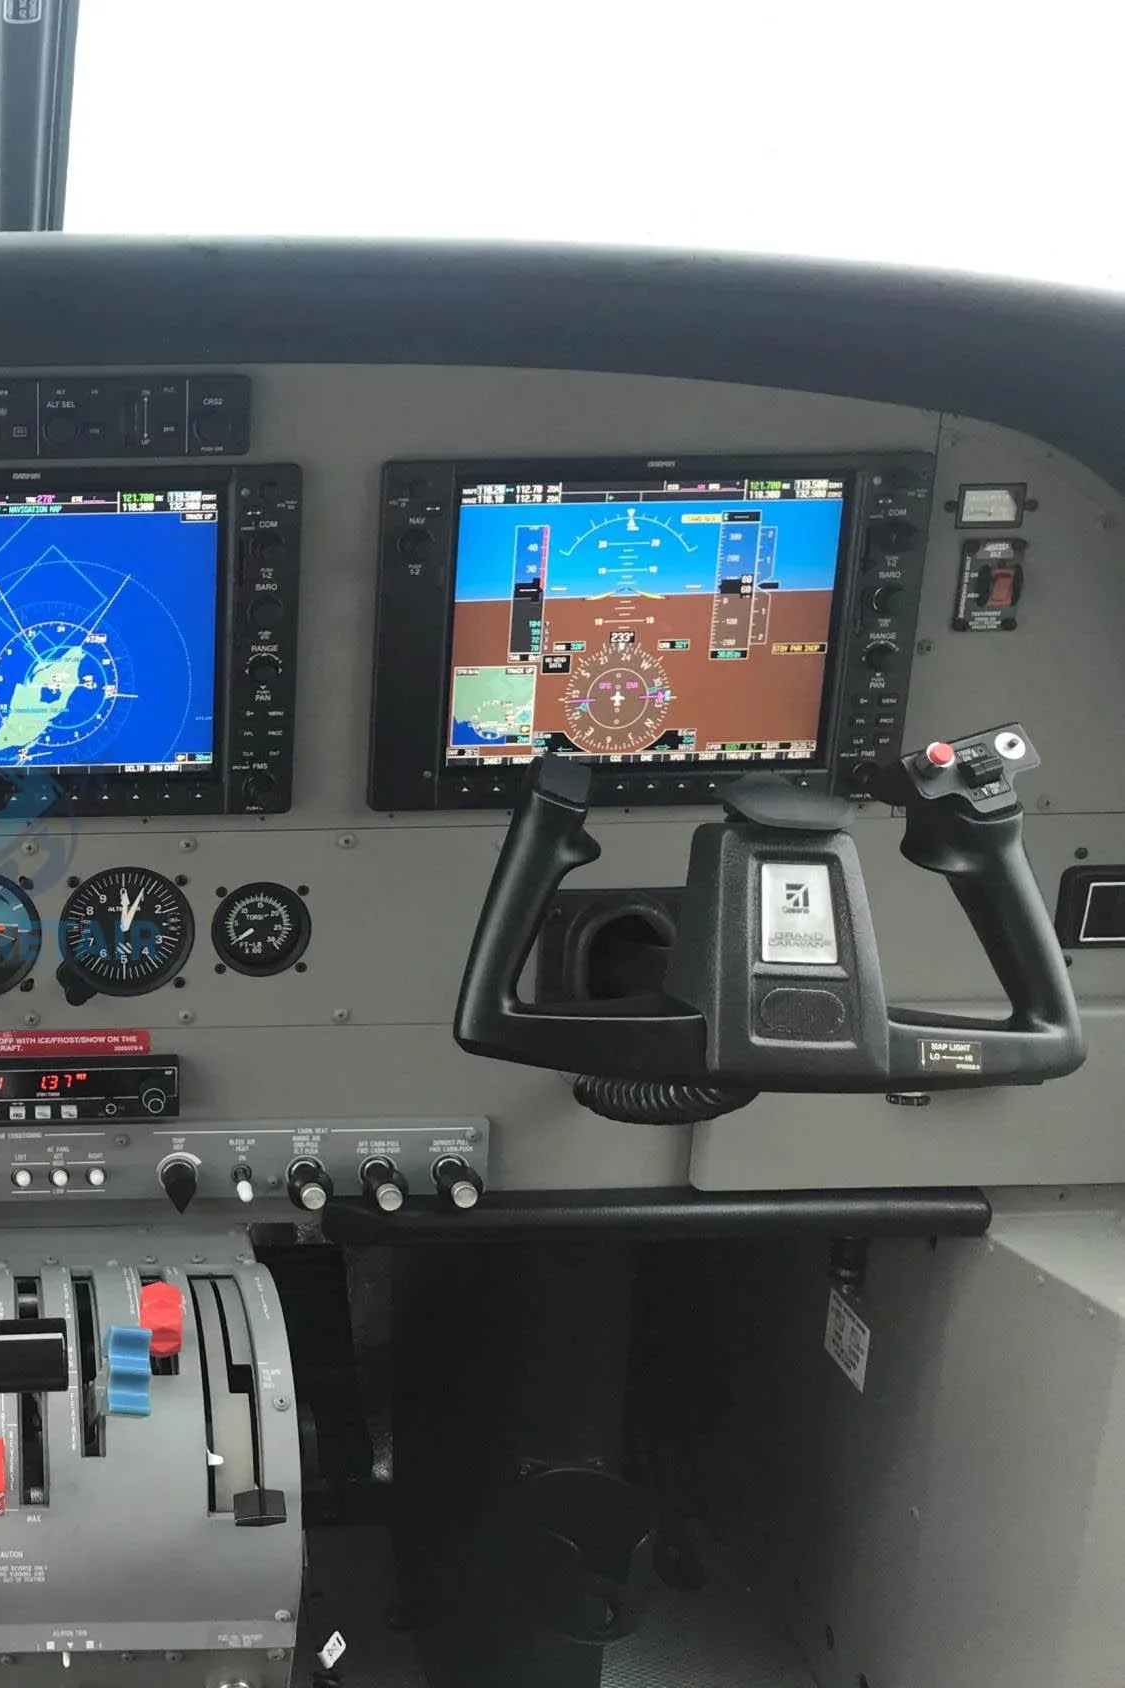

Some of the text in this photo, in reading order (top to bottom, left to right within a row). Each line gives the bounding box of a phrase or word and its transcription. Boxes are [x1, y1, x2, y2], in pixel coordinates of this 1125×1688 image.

[610, 632, 634, 642] 233°
[255, 694, 272, 702] PAN
[99, 894, 107, 904] 9
[86, 906, 94, 916] 8
[154, 904, 162, 914] 2
[156, 935, 163, 944] 3
[775, 932, 824, 940] GRAND
[88, 938, 94, 947] 7
[100, 948, 108, 958] 6
[142, 946, 150, 956] 4
[120, 955, 128, 964] 5
[949, 1044, 971, 1052] LIGHT
[964, 1054, 973, 1062] HI
[27, 1514, 42, 1522] MAX
